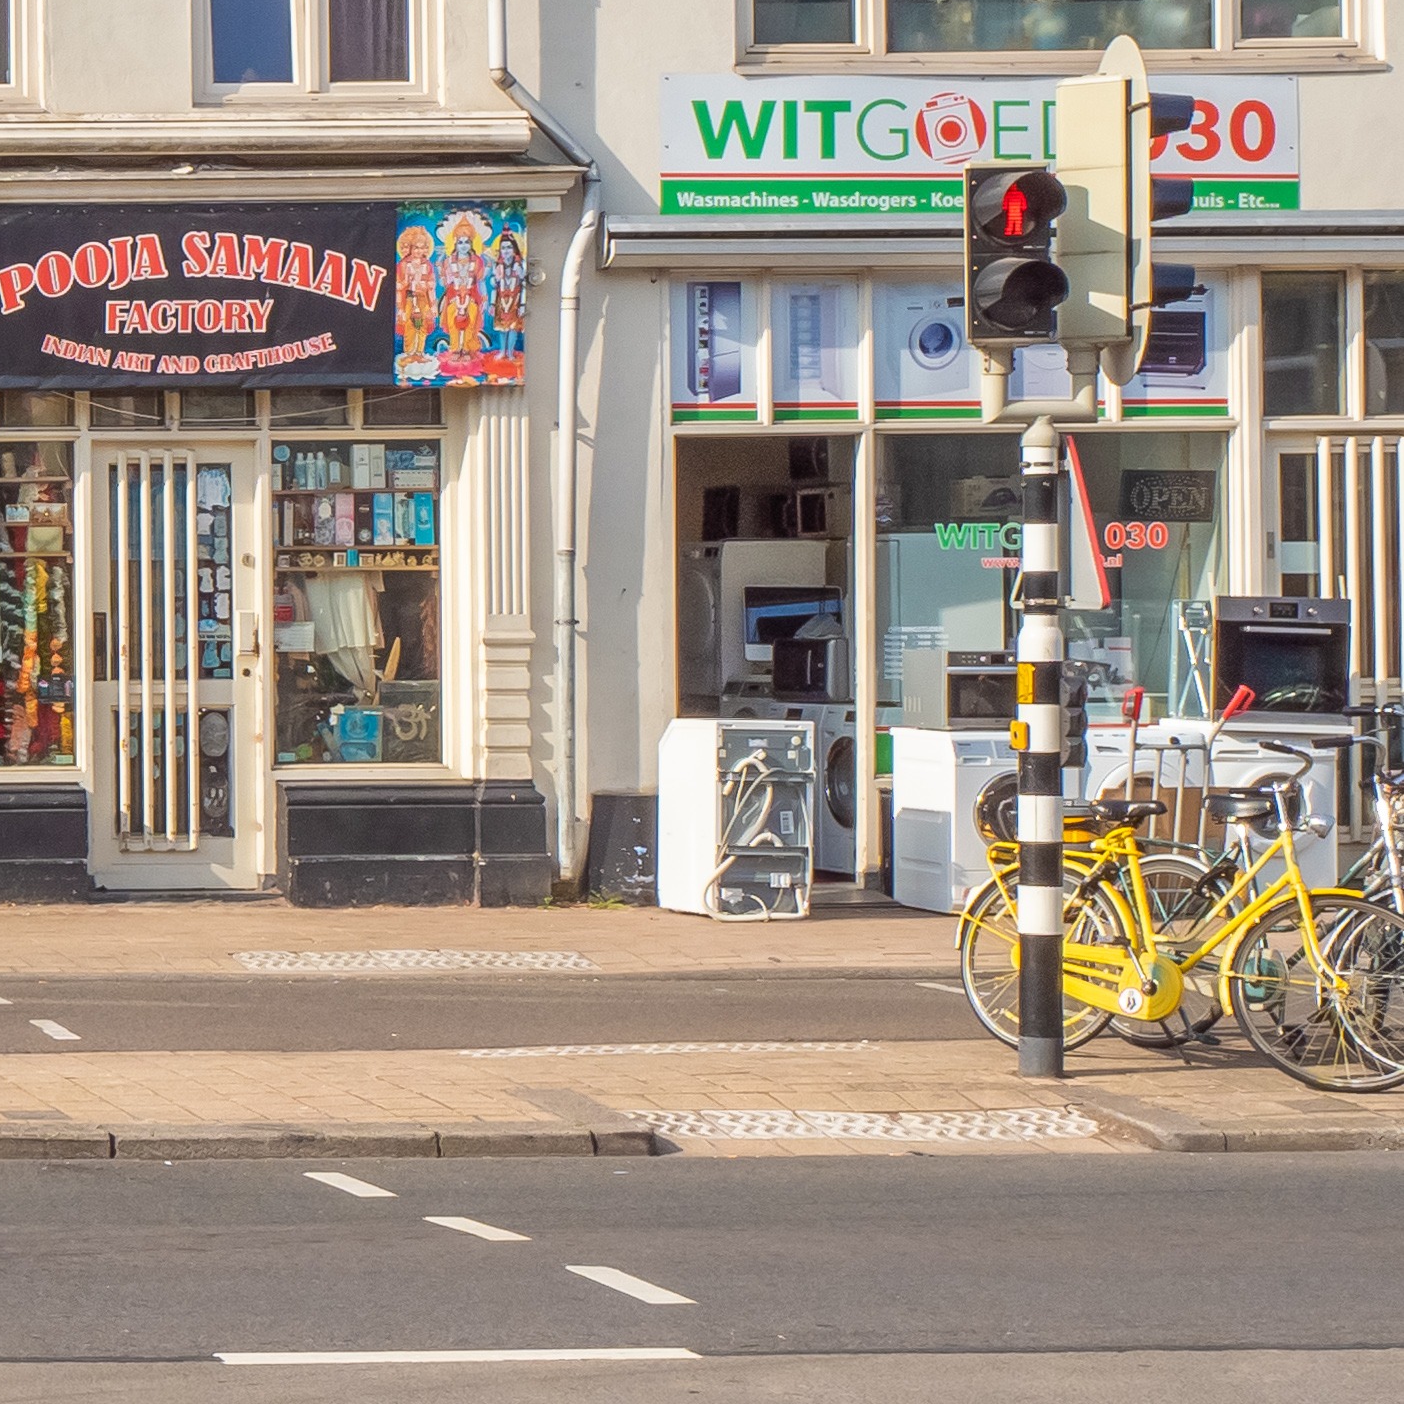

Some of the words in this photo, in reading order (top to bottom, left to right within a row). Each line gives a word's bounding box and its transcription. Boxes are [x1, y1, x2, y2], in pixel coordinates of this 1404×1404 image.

[691, 94, 1056, 163] WITGOE
[676, 190, 800, 209] Wasmachines
[811, 191, 918, 212] Wasdrogers
[181, 231, 387, 311] SAMAAN
[105, 298, 275, 334] FACTORY
[41, 334, 111, 368] INDIAN
[112, 351, 155, 374] ART
[157, 355, 200, 374] AND
[203, 332, 337, 372] CRAFTHOUSE
[1131, 477, 1207, 515] OPEN
[1104, 521, 1169, 550] 030
